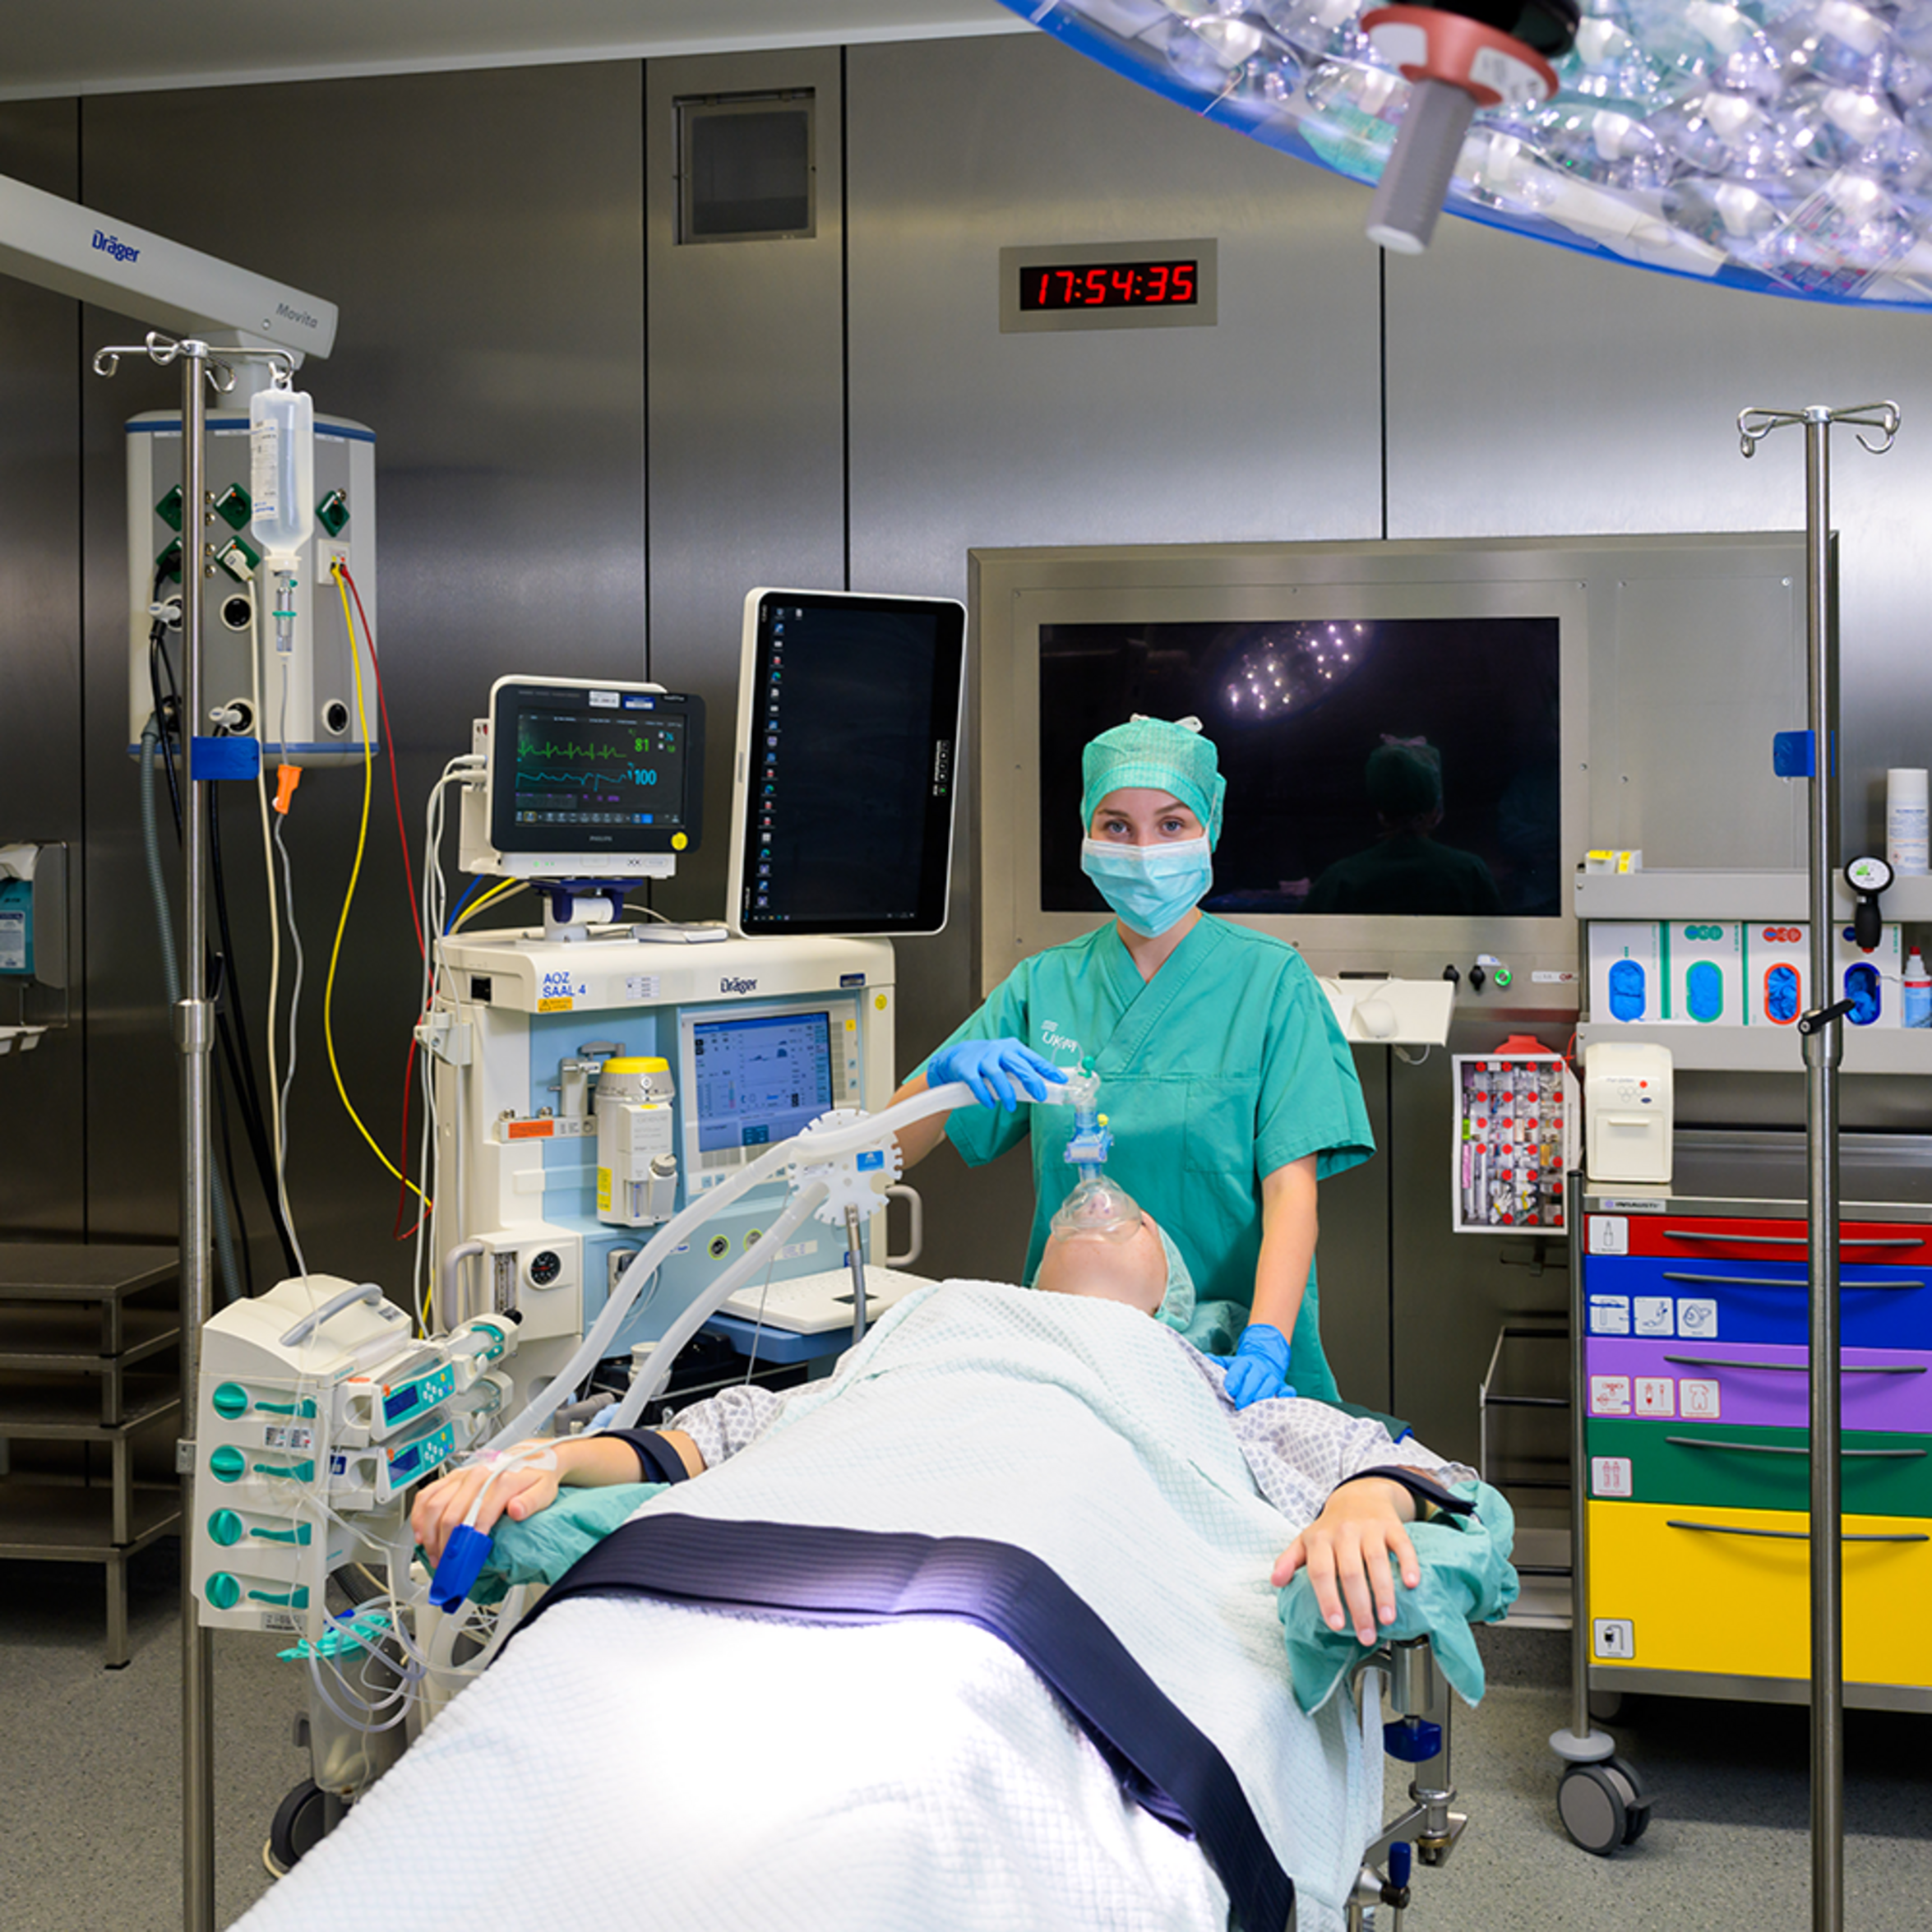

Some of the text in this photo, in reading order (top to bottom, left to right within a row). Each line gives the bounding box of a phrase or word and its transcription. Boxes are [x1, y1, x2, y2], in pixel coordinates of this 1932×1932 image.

[92, 229, 140, 262] Dräger
[1038, 266, 1194, 305] 17:54:35
[275, 303, 318, 328] Movita
[635, 737, 649, 752] 81
[635, 769, 657, 785] 100
[543, 972, 570, 984] AOZ
[720, 978, 757, 995] Dräger
[543, 985, 586, 998] SAAL 4
[1042, 1031, 1078, 1052] UKM
